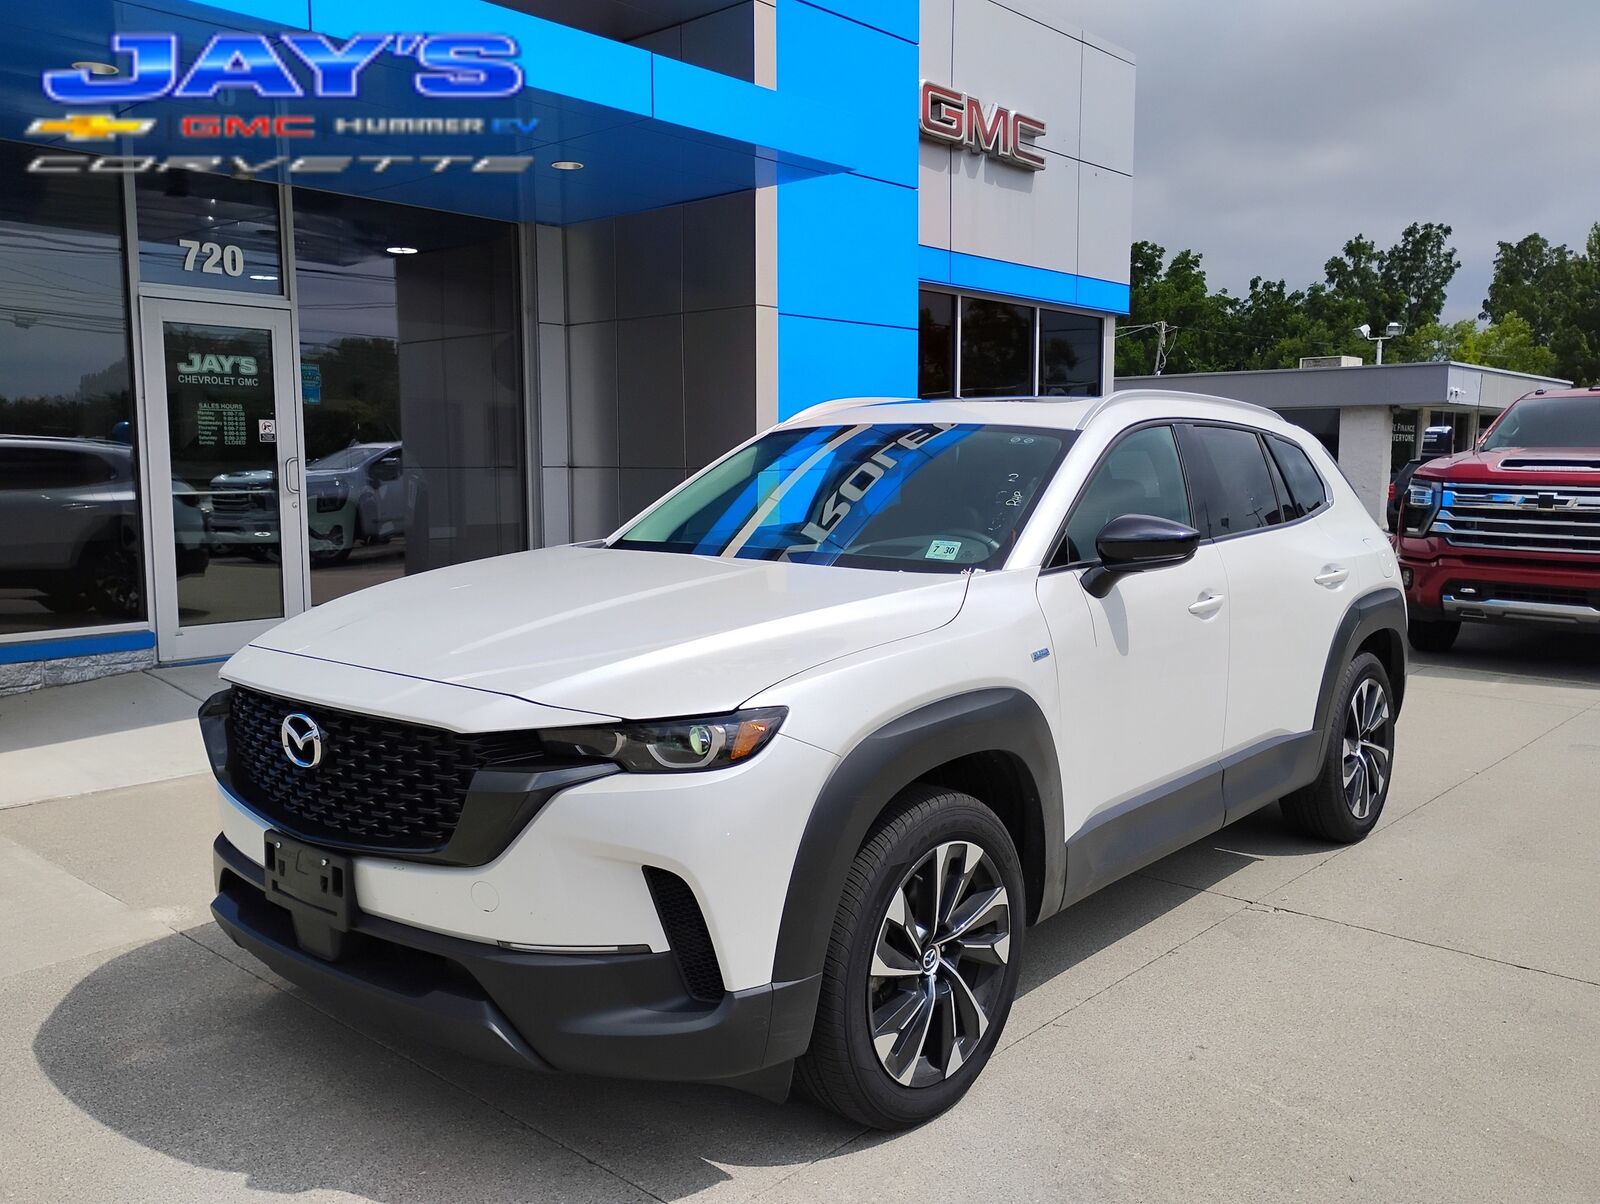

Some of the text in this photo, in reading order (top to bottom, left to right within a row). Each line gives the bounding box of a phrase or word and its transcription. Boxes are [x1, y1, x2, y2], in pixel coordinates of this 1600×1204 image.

[919, 79, 1046, 171] GMC
[178, 239, 244, 277] 720
[177, 353, 259, 375] JAY'S
[178, 375, 259, 387] CHEVROLET GMC
[1397, 423, 1415, 432] FINANCE
[933, 545, 955, 554] 7 30
